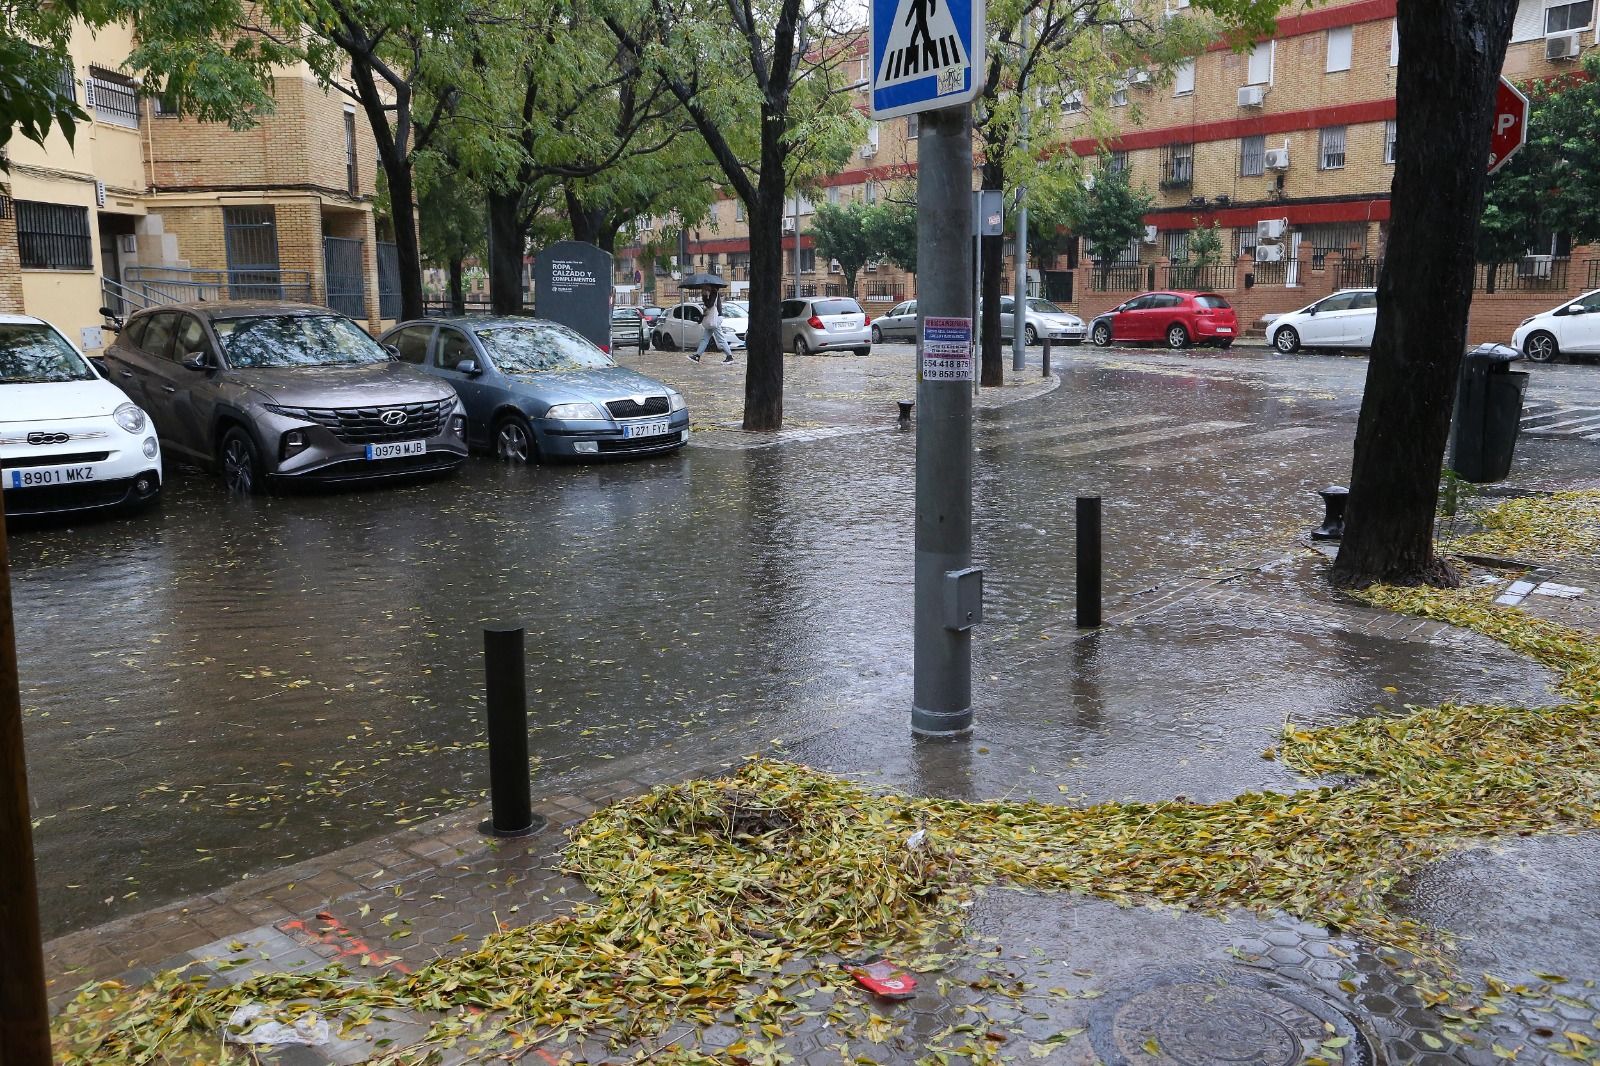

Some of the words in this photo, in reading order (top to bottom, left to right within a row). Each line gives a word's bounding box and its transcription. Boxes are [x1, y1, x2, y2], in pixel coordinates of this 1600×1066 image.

[631, 426, 649, 436] 1271
[652, 424, 666, 433] FYZ
[376, 445, 401, 456] 0979
[404, 443, 422, 454] MJB
[24, 470, 60, 485] 8901
[66, 467, 94, 481] MKZ
